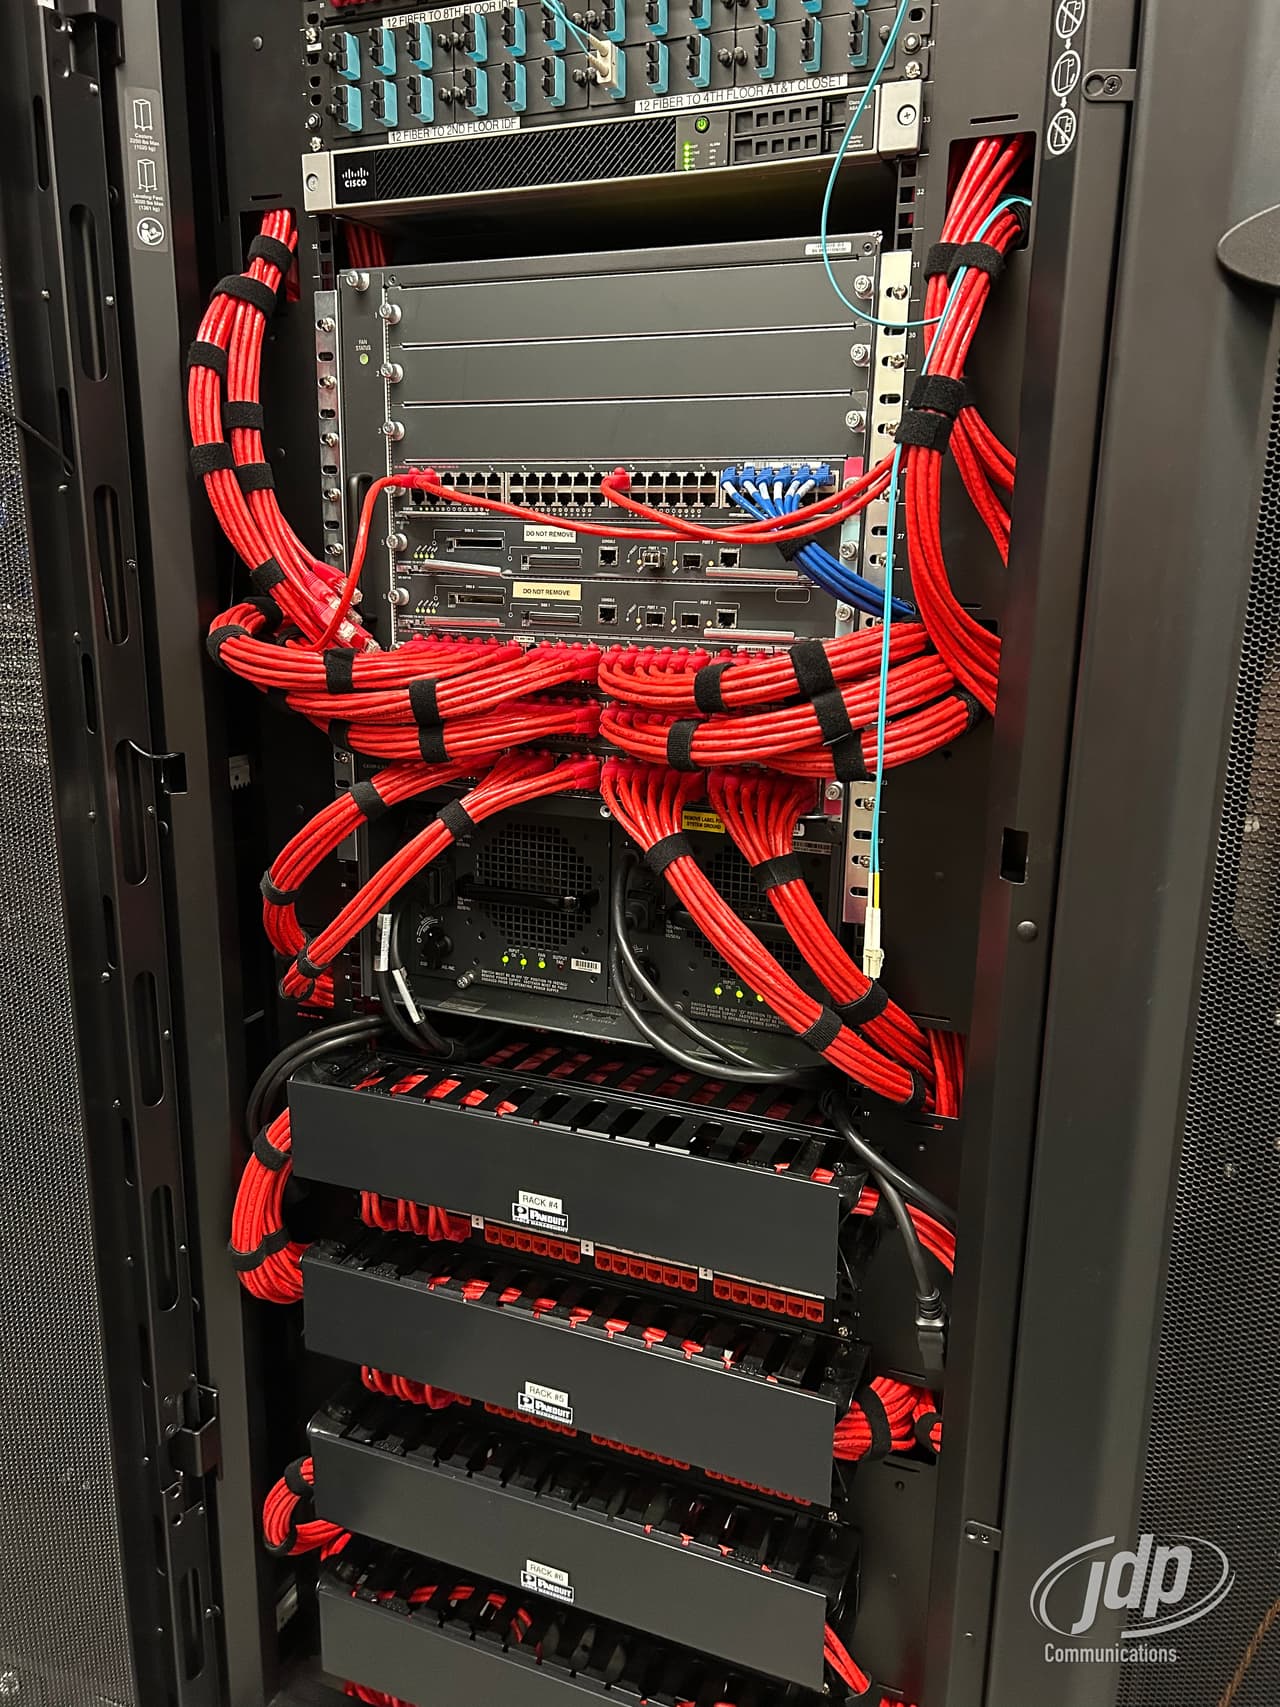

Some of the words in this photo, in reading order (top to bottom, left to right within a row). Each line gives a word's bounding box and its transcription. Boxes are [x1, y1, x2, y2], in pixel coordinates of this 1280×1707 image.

[387, 18, 397, 28] 12
[399, 13, 426, 25] FIBER
[429, 11, 441, 20] TO
[443, 7, 461, 18] 8TH
[464, 2, 496, 14] FLOOR
[639, 101, 650, 111] 12
[652, 97, 684, 110] FIBER
[687, 94, 701, 104] TO
[703, 92, 724, 103] 4TH
[727, 84, 764, 101] FLOOR
[766, 80, 795, 94] AT&T
[798, 76, 843, 90] CLOSET
[392, 132, 402, 142] 12
[404, 128, 430, 140] FIBER
[432, 126, 445, 136] TO
[447, 124, 466, 136] 2ND
[468, 120, 500, 132] FLOOR
[502, 118, 517, 129] IDF
[344, 178, 367, 188] CISCO
[916, 188, 924, 196] 32
[522, 1194, 546, 1206] RACK
[530, 1209, 566, 1226] PANDUIT
[529, 1385, 552, 1399] RACK
[554, 1394, 564, 1402] #5
[535, 1400, 570, 1418] PANDUIT
[530, 1564, 552, 1578] RACK
[538, 1579, 572, 1597] PANDUIT
